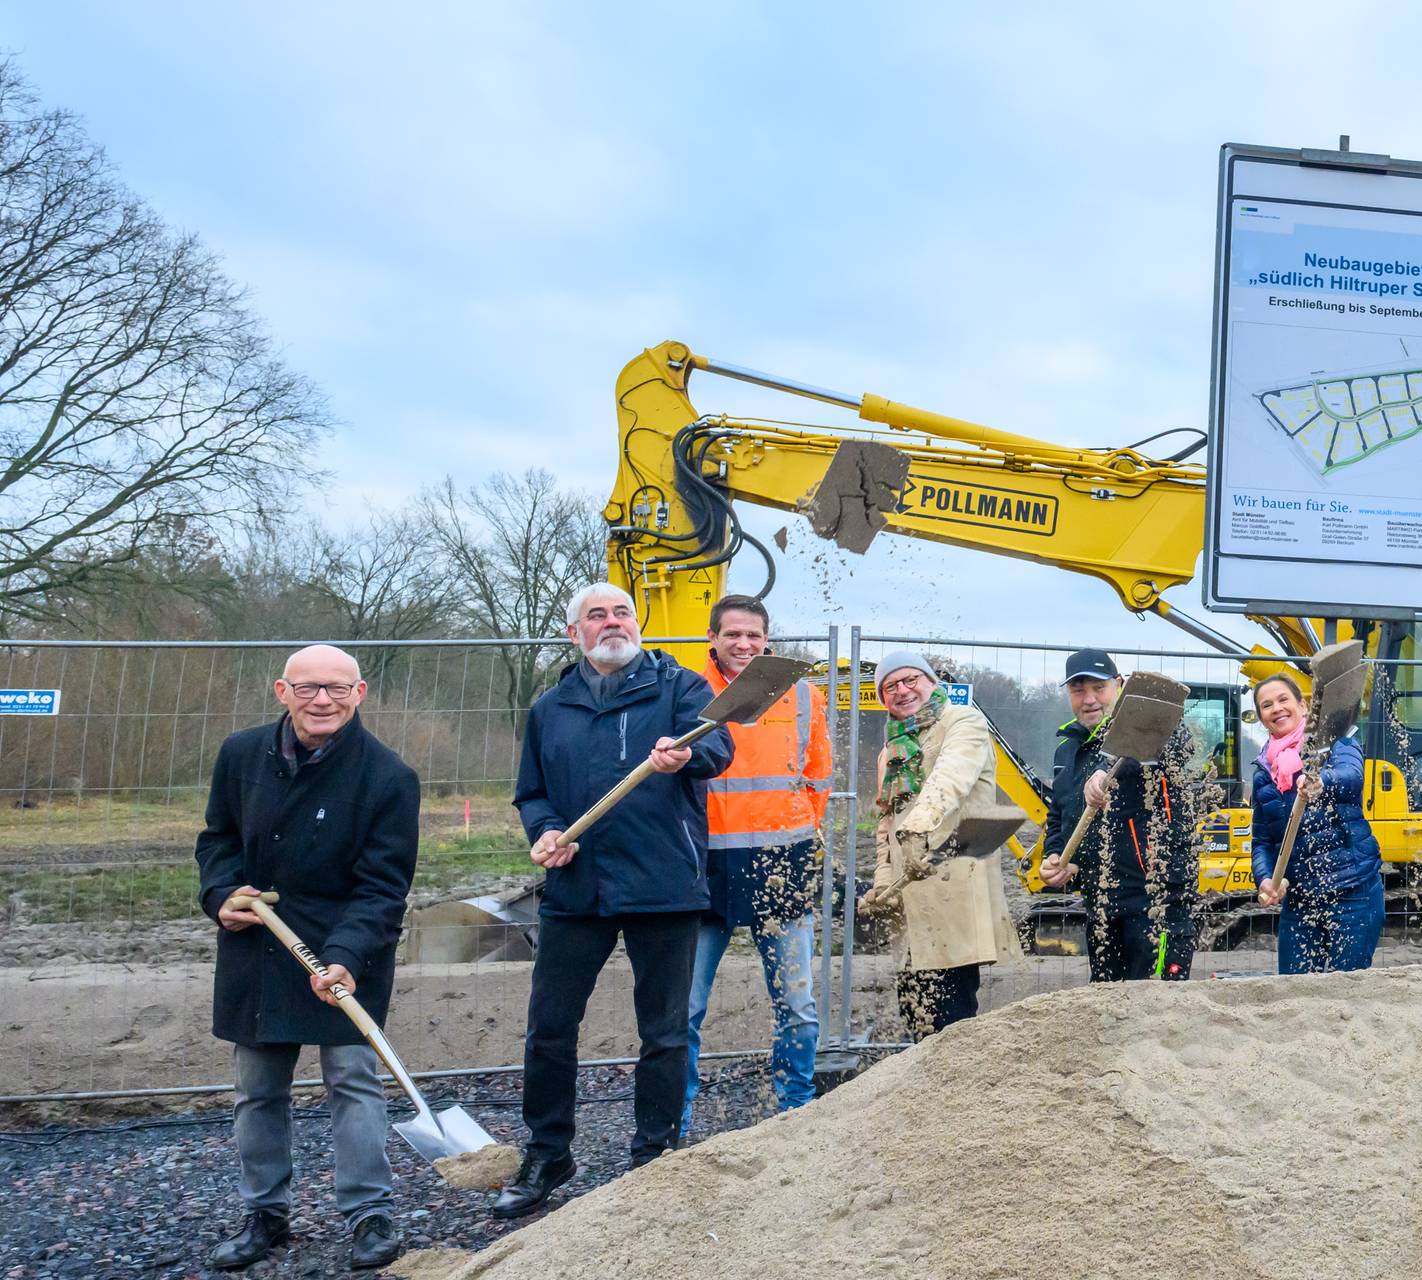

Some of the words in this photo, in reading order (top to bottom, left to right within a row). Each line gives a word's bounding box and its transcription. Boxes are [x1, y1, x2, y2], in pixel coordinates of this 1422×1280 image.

[1249, 270, 1324, 289] „südlich
[1330, 275, 1408, 297] Hiltruper
[1268, 296, 1345, 314] Erschließung
[1349, 303, 1366, 313] bis
[920, 485, 1048, 526] POLLMANN
[1233, 494, 1259, 508] Wir
[1262, 496, 1301, 510] bauen
[1306, 498, 1326, 512] für
[1329, 500, 1352, 513] Sie.
[0, 691, 52, 704] weko
